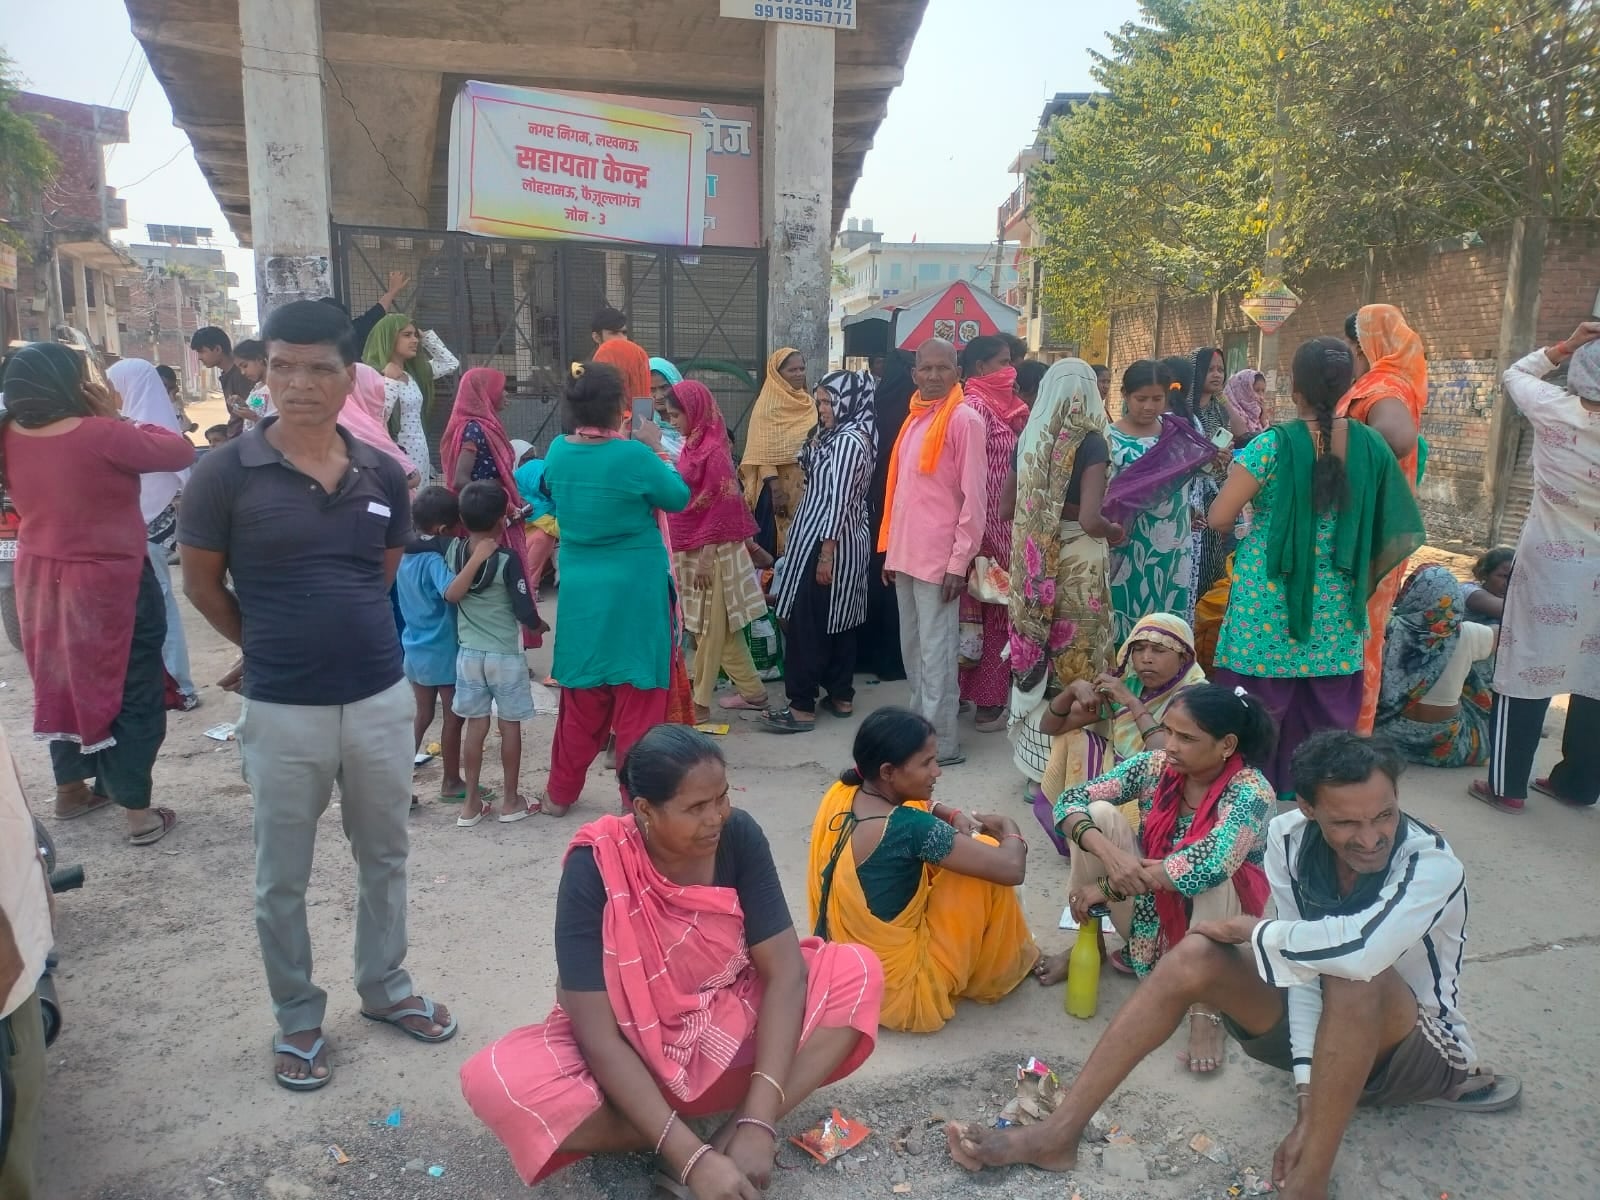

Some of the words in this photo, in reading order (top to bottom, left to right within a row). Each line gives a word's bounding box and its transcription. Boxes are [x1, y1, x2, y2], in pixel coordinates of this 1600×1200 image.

[755, 4, 852, 25] 9919355777
[528, 122, 555, 138] नगर
[557, 124, 592, 146] निगम,
[594, 133, 640, 152] लखनऊ
[515, 145, 599, 180] सहायता
[602, 153, 650, 189] केन्द्र
[521, 177, 578, 201] लोहरामऊ,
[564, 205, 589, 222] जोन
[598, 213, 606, 225] 3
